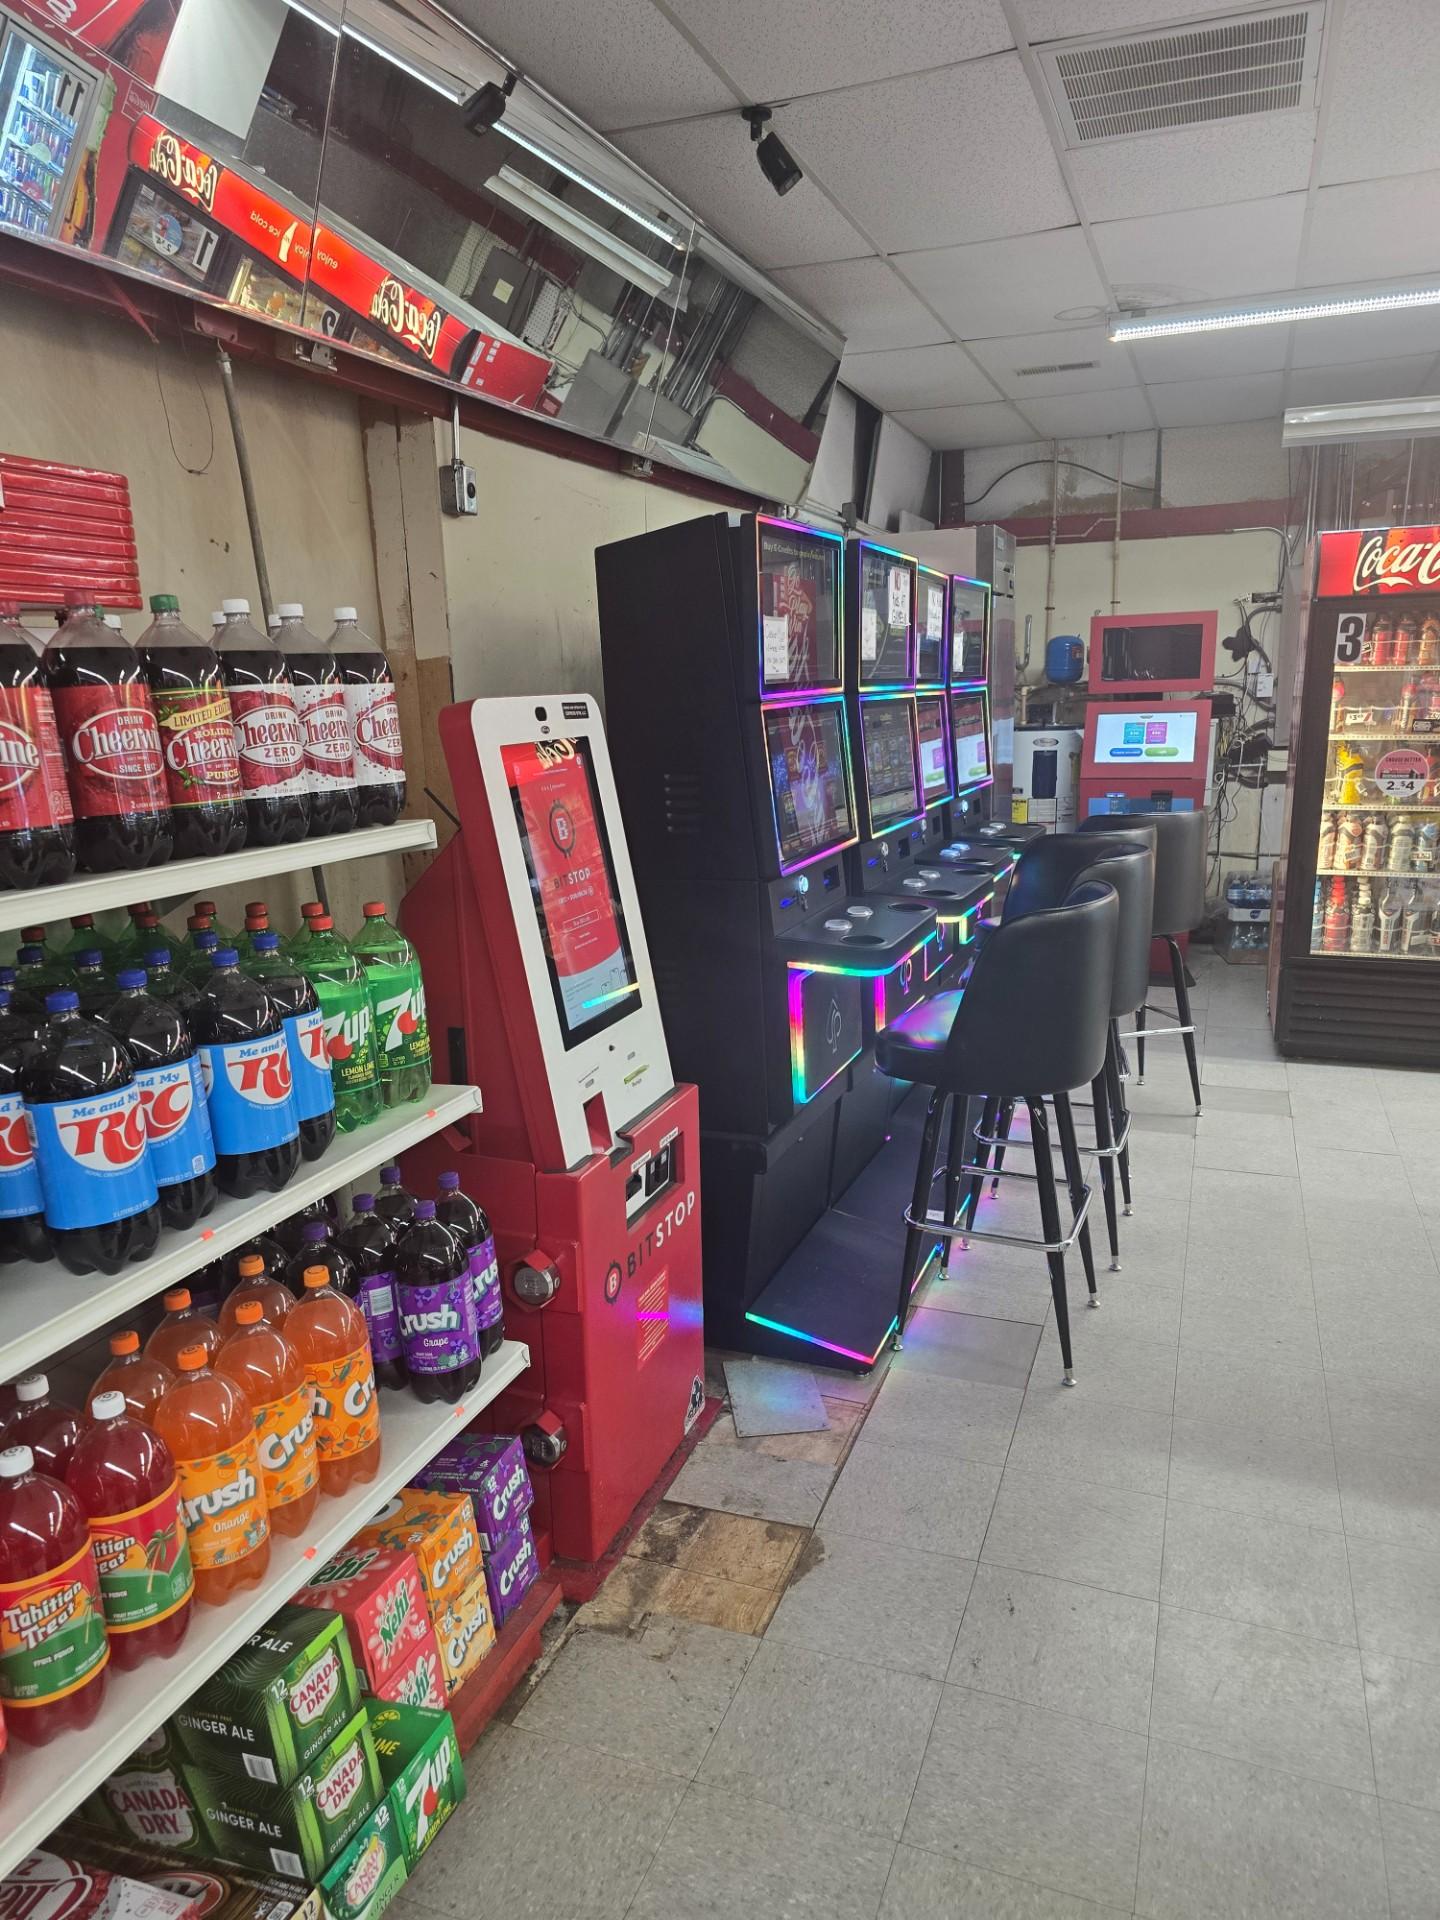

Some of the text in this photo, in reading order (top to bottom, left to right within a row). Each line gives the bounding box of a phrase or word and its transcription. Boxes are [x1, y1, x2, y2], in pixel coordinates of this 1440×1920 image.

[1353, 535, 1440, 592] Coca-C
[1336, 615, 1365, 663] 3
[118, 715, 144, 726] DRINK
[174, 709, 212, 727] LIMITED
[264, 711, 287, 721] DRINK
[355, 715, 400, 746] Cheer
[73, 722, 162, 764] Cheerwi
[233, 720, 300, 752] heerwi
[324, 742, 350, 754] ZERO
[166, 736, 238, 771] Cheerw
[263, 745, 296, 758] ZERO
[119, 763, 142, 774] SINCE
[1386, 780, 1395, 791] 2
[240, 1047, 258, 1059] Me
[261, 1041, 280, 1053] and
[137, 1071, 180, 1087] nd My
[72, 1106, 96, 1119] Me
[99, 1099, 125, 1112] and
[626, 1190, 696, 1279] BITSTOP
[423, 1337, 449, 1348] Grape
[493, 1464, 525, 1521] Crush
[213, 1510, 250, 1533] Orange
[95, 1536, 137, 1559] itian
[432, 1527, 474, 1589] Crush
[98, 1551, 129, 1575] eat
[306, 1551, 380, 1588] ehi
[500, 1538, 533, 1597] Crush
[3, 1579, 82, 1633] Tahitian
[21, 1602, 75, 1650] Treat
[447, 1602, 489, 1669] Crush
[259, 1637, 294, 1654] ALE
[271, 1678, 288, 1701] 12
[289, 1655, 341, 1713] CANADA
[306, 1680, 331, 1715] DRY
[177, 1713, 256, 1742] GINGER ALE
[304, 1709, 347, 1760] GINGER ALE
[298, 1775, 315, 1799] 12
[316, 1746, 365, 1810] CANADA
[332, 1776, 357, 1810] DRY
[105, 1785, 195, 1814] CANADA
[138, 1814, 184, 1835] DRY
[206, 1807, 283, 1838] GINGER ALE
[330, 1819, 357, 1854] GINGER
[357, 1802, 371, 1821] ALE
[375, 1805, 390, 1825] 12
